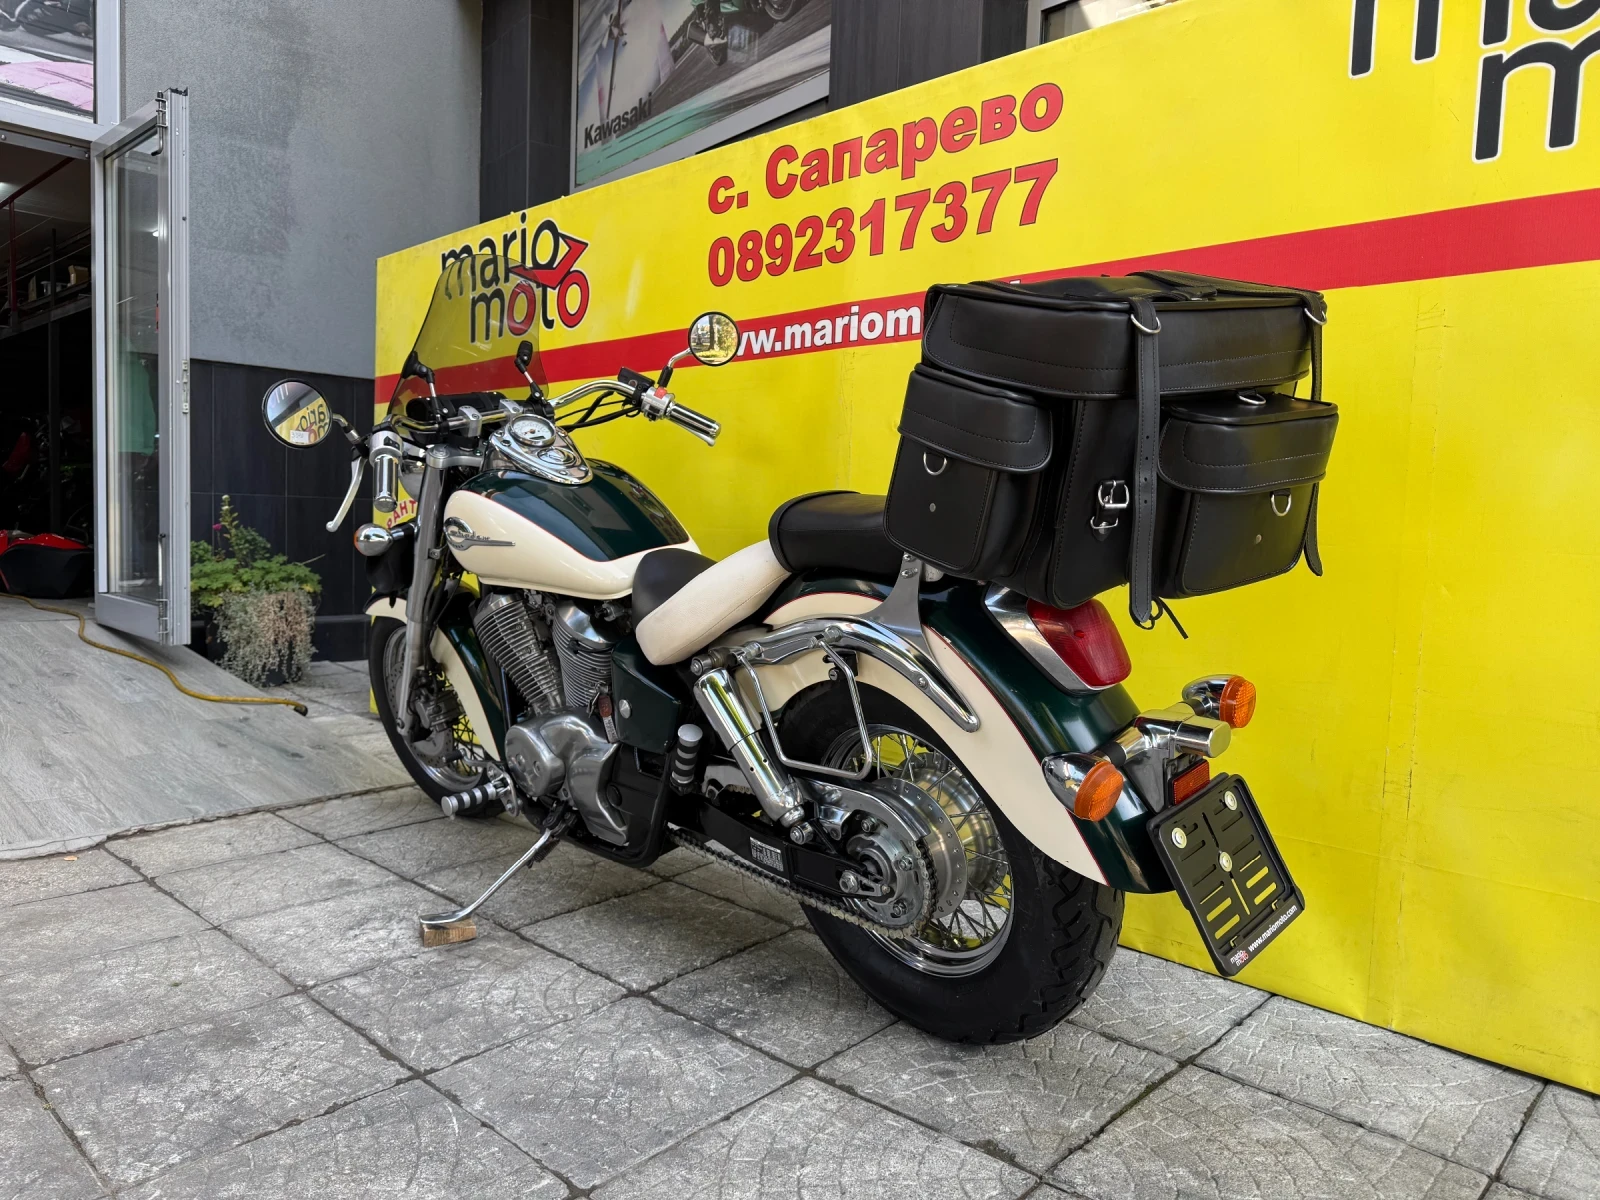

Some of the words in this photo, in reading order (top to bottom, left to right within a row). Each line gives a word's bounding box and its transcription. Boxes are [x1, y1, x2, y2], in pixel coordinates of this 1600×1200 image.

[584, 92, 653, 149] Kawasaki
[765, 82, 1064, 199] Сапарево
[441, 212, 560, 300] mario
[707, 158, 1059, 287] 0892317377
[469, 268, 591, 344] moto
[1247, 904, 1298, 952] www.mariomoto.com
